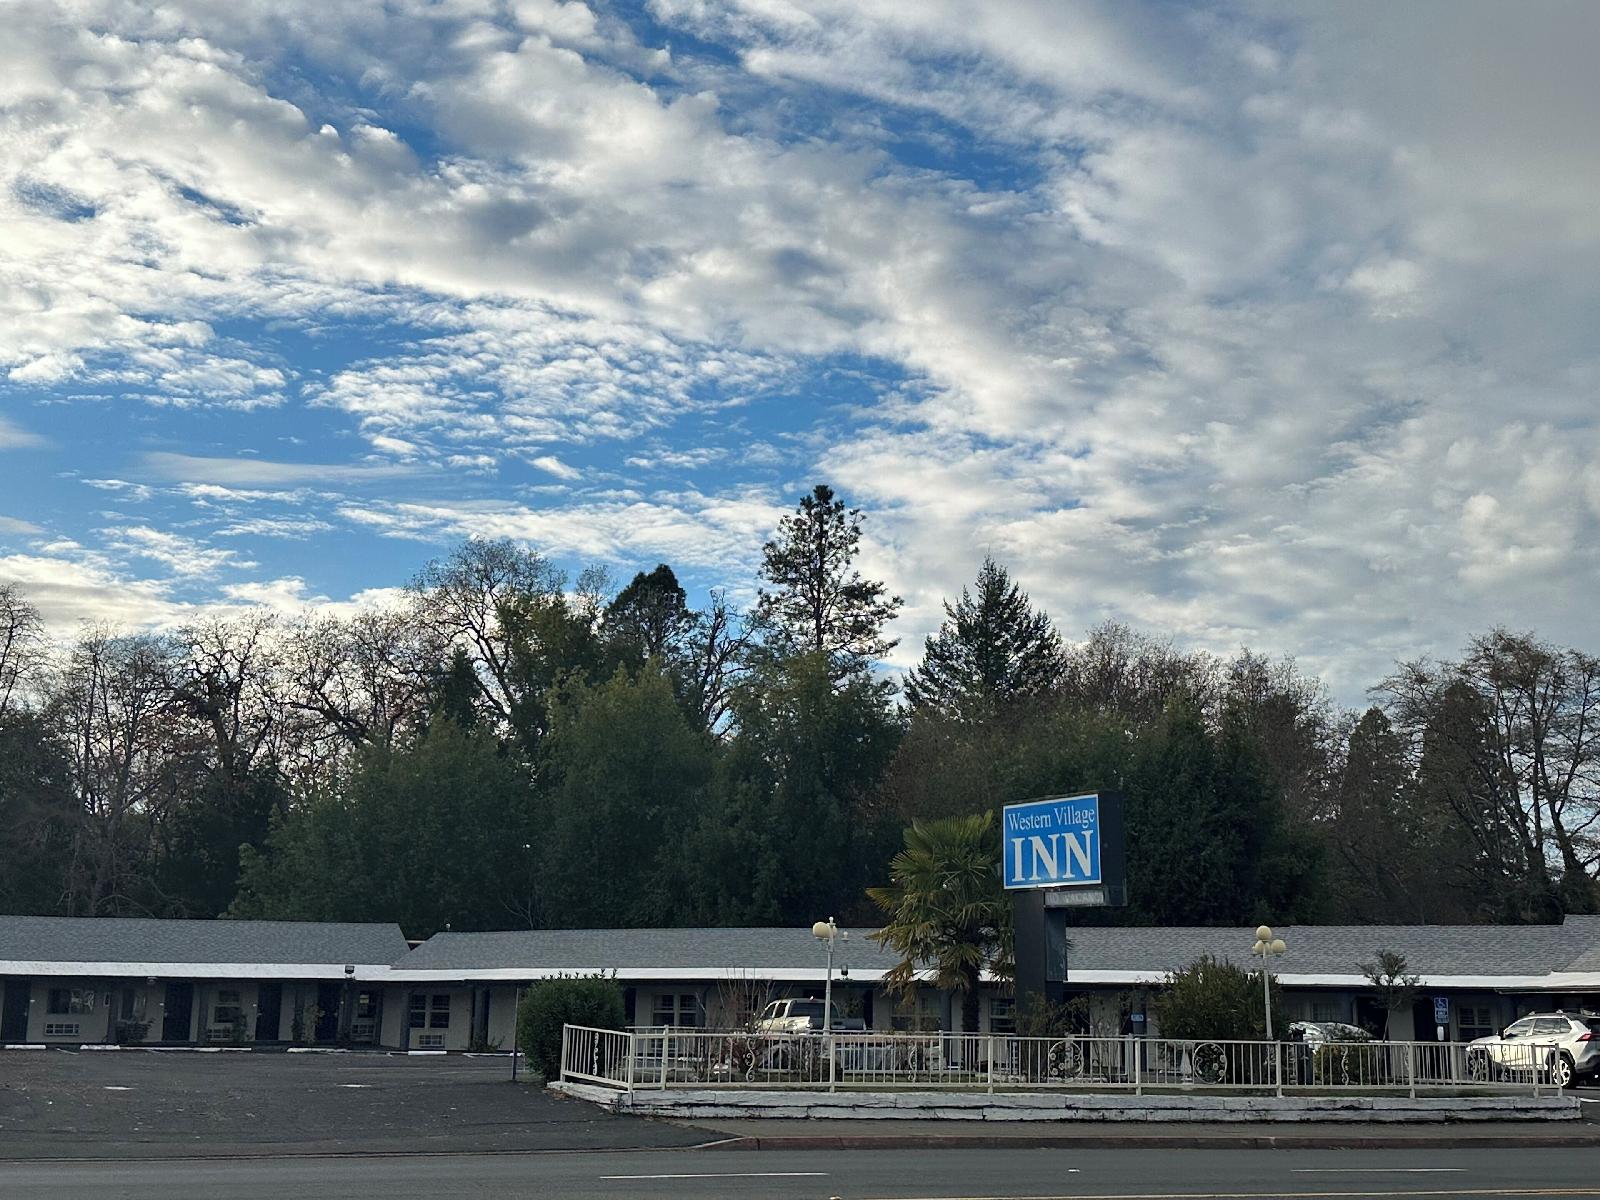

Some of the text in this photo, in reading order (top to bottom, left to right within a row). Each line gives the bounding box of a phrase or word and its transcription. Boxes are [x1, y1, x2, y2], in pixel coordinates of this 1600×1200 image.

[1008, 805, 1095, 831] Western Village
[1010, 829, 1094, 882] INN
